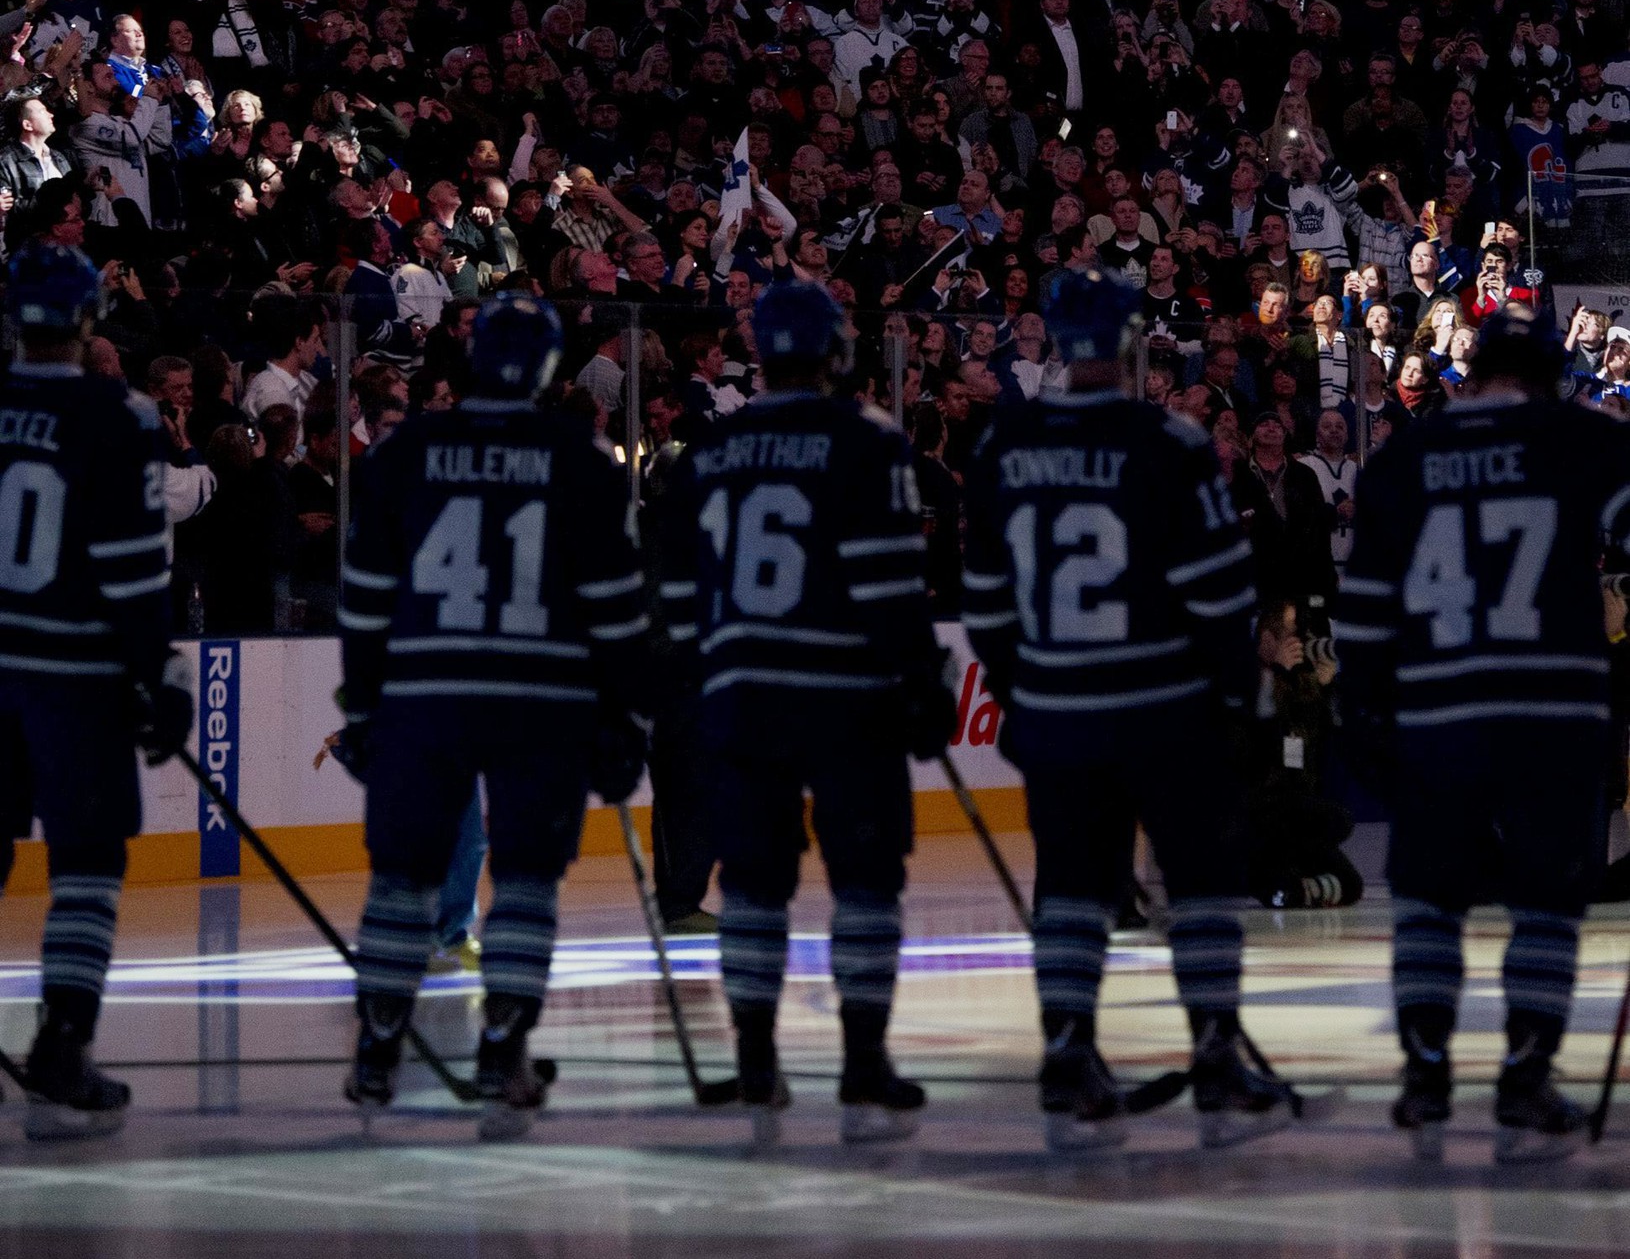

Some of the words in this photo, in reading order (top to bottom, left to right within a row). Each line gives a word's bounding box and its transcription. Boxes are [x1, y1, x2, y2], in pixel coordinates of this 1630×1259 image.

[1611, 93, 1620, 110] C
[1170, 299, 1181, 317] C
[1422, 441, 1528, 492] BOYCE
[411, 494, 551, 637] 41
[698, 481, 814, 626] 16
[1003, 501, 1130, 643] 12
[1401, 493, 1560, 650] 47
